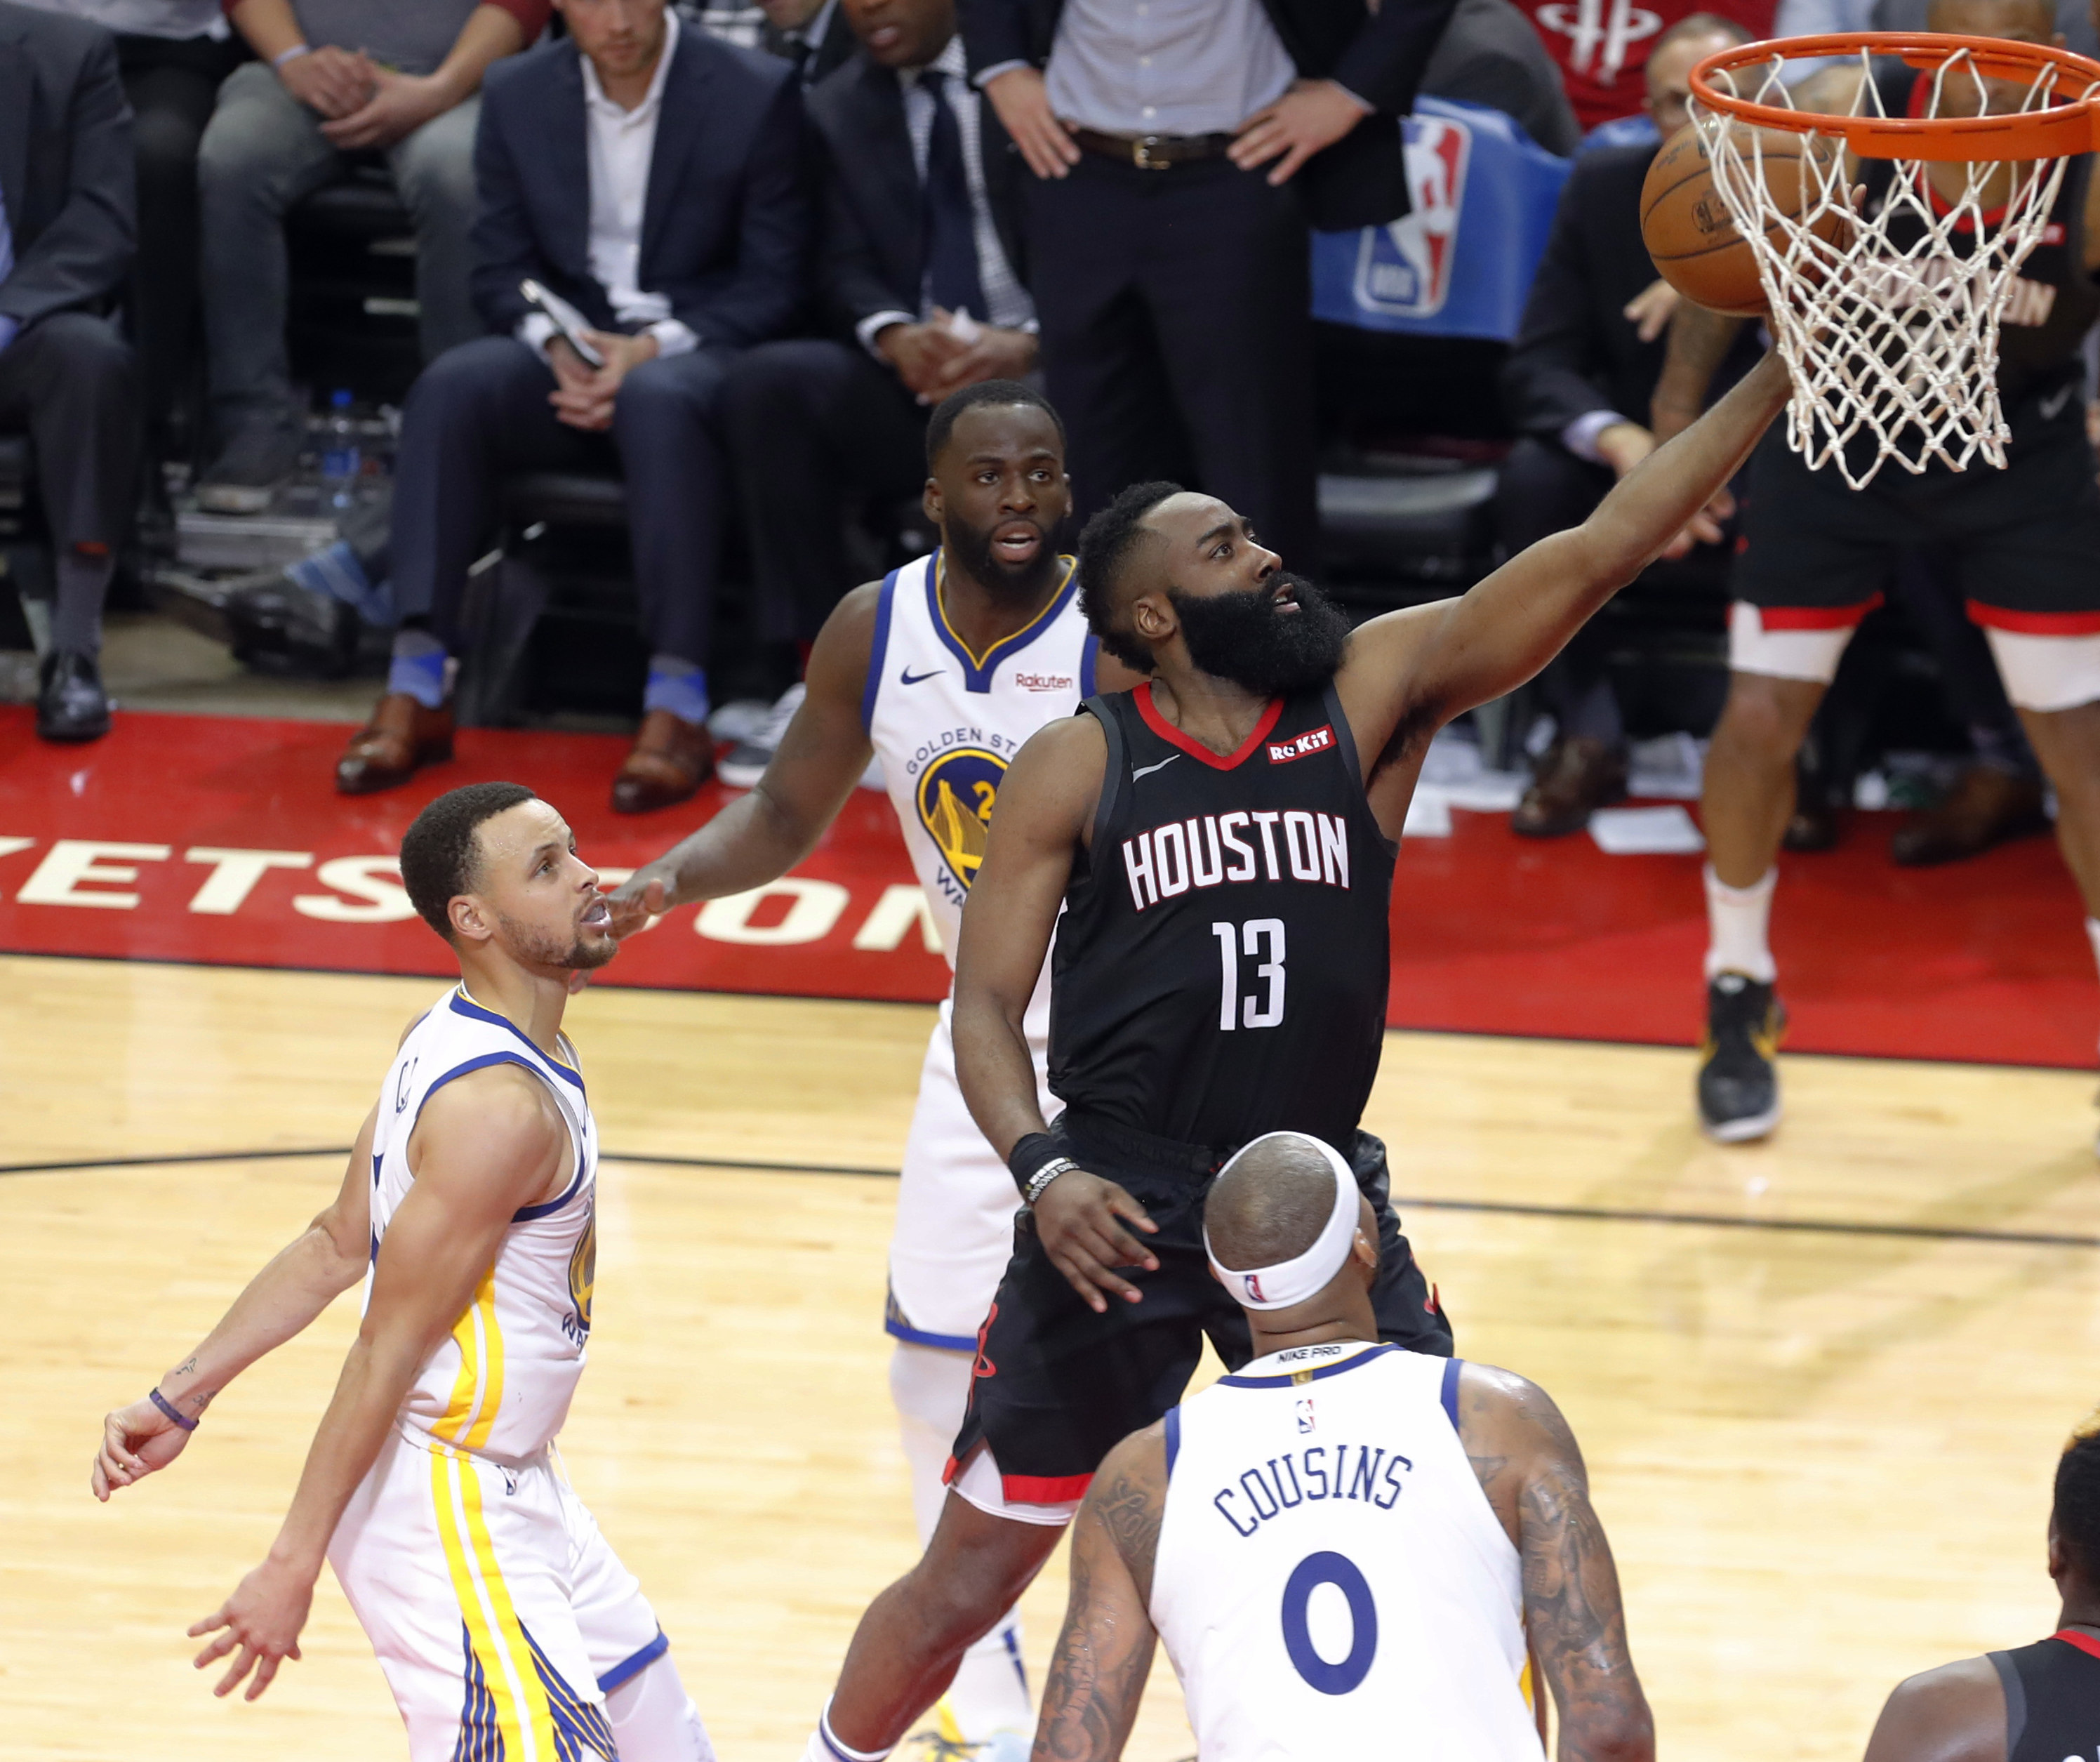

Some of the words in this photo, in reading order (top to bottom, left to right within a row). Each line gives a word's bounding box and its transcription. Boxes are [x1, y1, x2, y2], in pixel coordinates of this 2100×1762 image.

[1016, 673, 1072, 689] Rakuten
[907, 727, 982, 774] GOLDEN
[990, 734, 1018, 757] ST
[0, 835, 421, 923] ETS
[1122, 809, 1351, 913] HOUSTON
[1212, 918, 1287, 1031] 13
[1277, 1349, 1310, 1364] NIKE
[1310, 1346, 1342, 1358] PRO
[1214, 1444, 1414, 1538] COUSINS
[1281, 1550, 1378, 1696] 0
